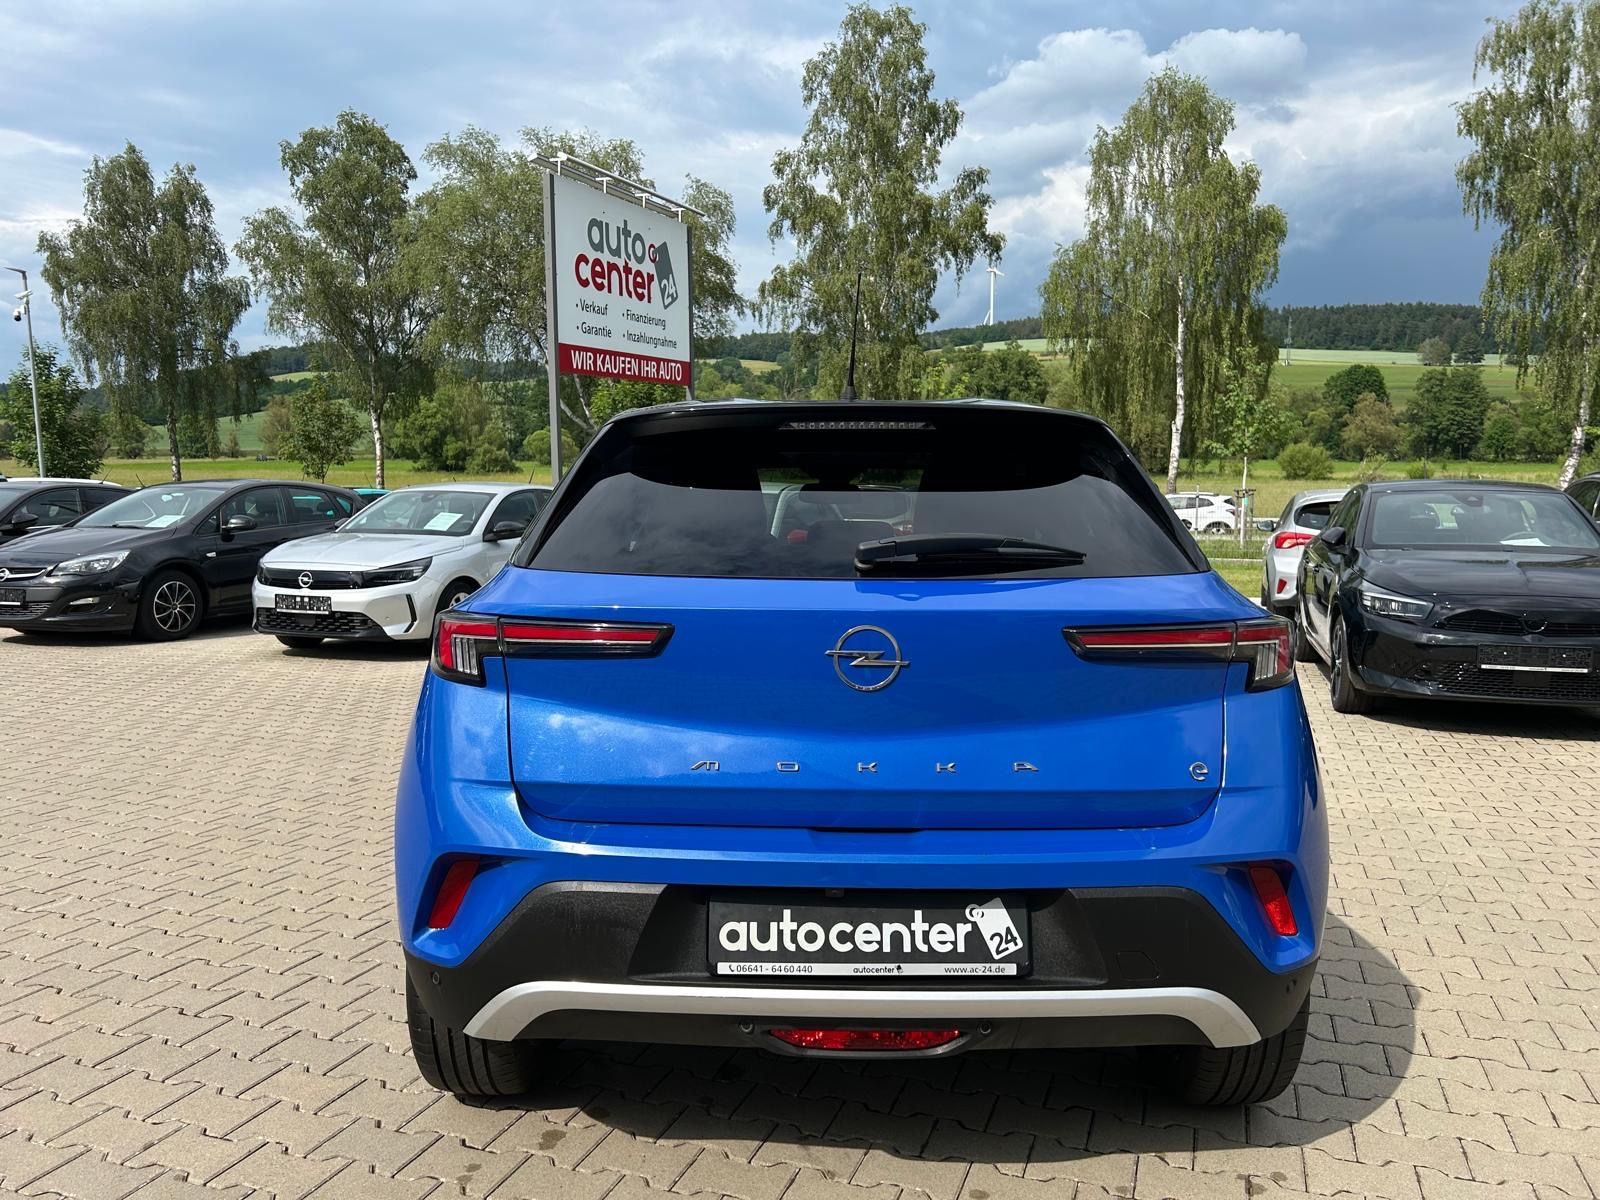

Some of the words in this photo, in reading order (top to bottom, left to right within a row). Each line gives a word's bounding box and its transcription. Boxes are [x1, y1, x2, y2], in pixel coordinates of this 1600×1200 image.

[587, 217, 645, 264] auto
[575, 253, 655, 303] center
[661, 274, 677, 304] 24
[580, 299, 608, 316] Verkauf
[581, 321, 612, 338] Garantie
[626, 309, 666, 330] Finanzierung
[626, 329, 677, 349] Inzahlungnahme
[571, 349, 594, 371] WIR
[597, 354, 639, 376] KAUFEN
[641, 360, 657, 378] IHR
[659, 362, 682, 381] AUTO
[989, 926, 1018, 955] 24
[736, 964, 763, 973] 06641
[853, 964, 895, 974] autocenter
[944, 963, 1006, 974] www.ac-24.de
